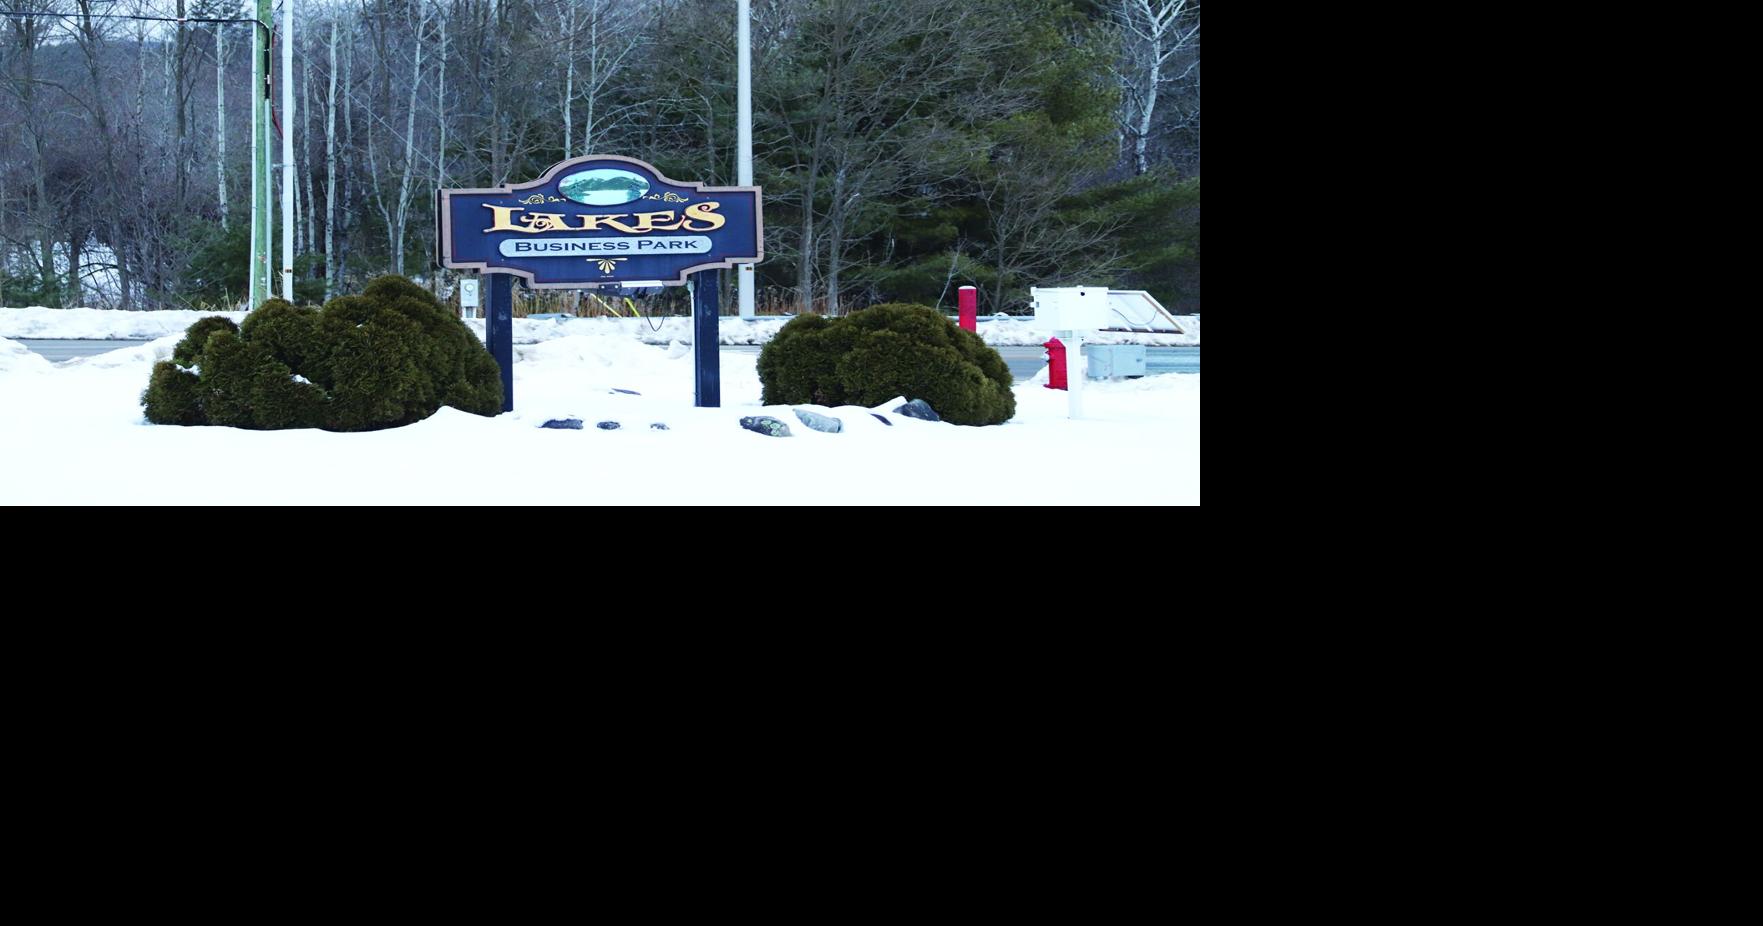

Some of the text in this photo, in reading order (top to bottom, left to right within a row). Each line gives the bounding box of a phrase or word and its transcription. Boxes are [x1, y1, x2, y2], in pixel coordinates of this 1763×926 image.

[482, 201, 726, 233] LAKES
[515, 240, 698, 252] BUSINESS PARK
